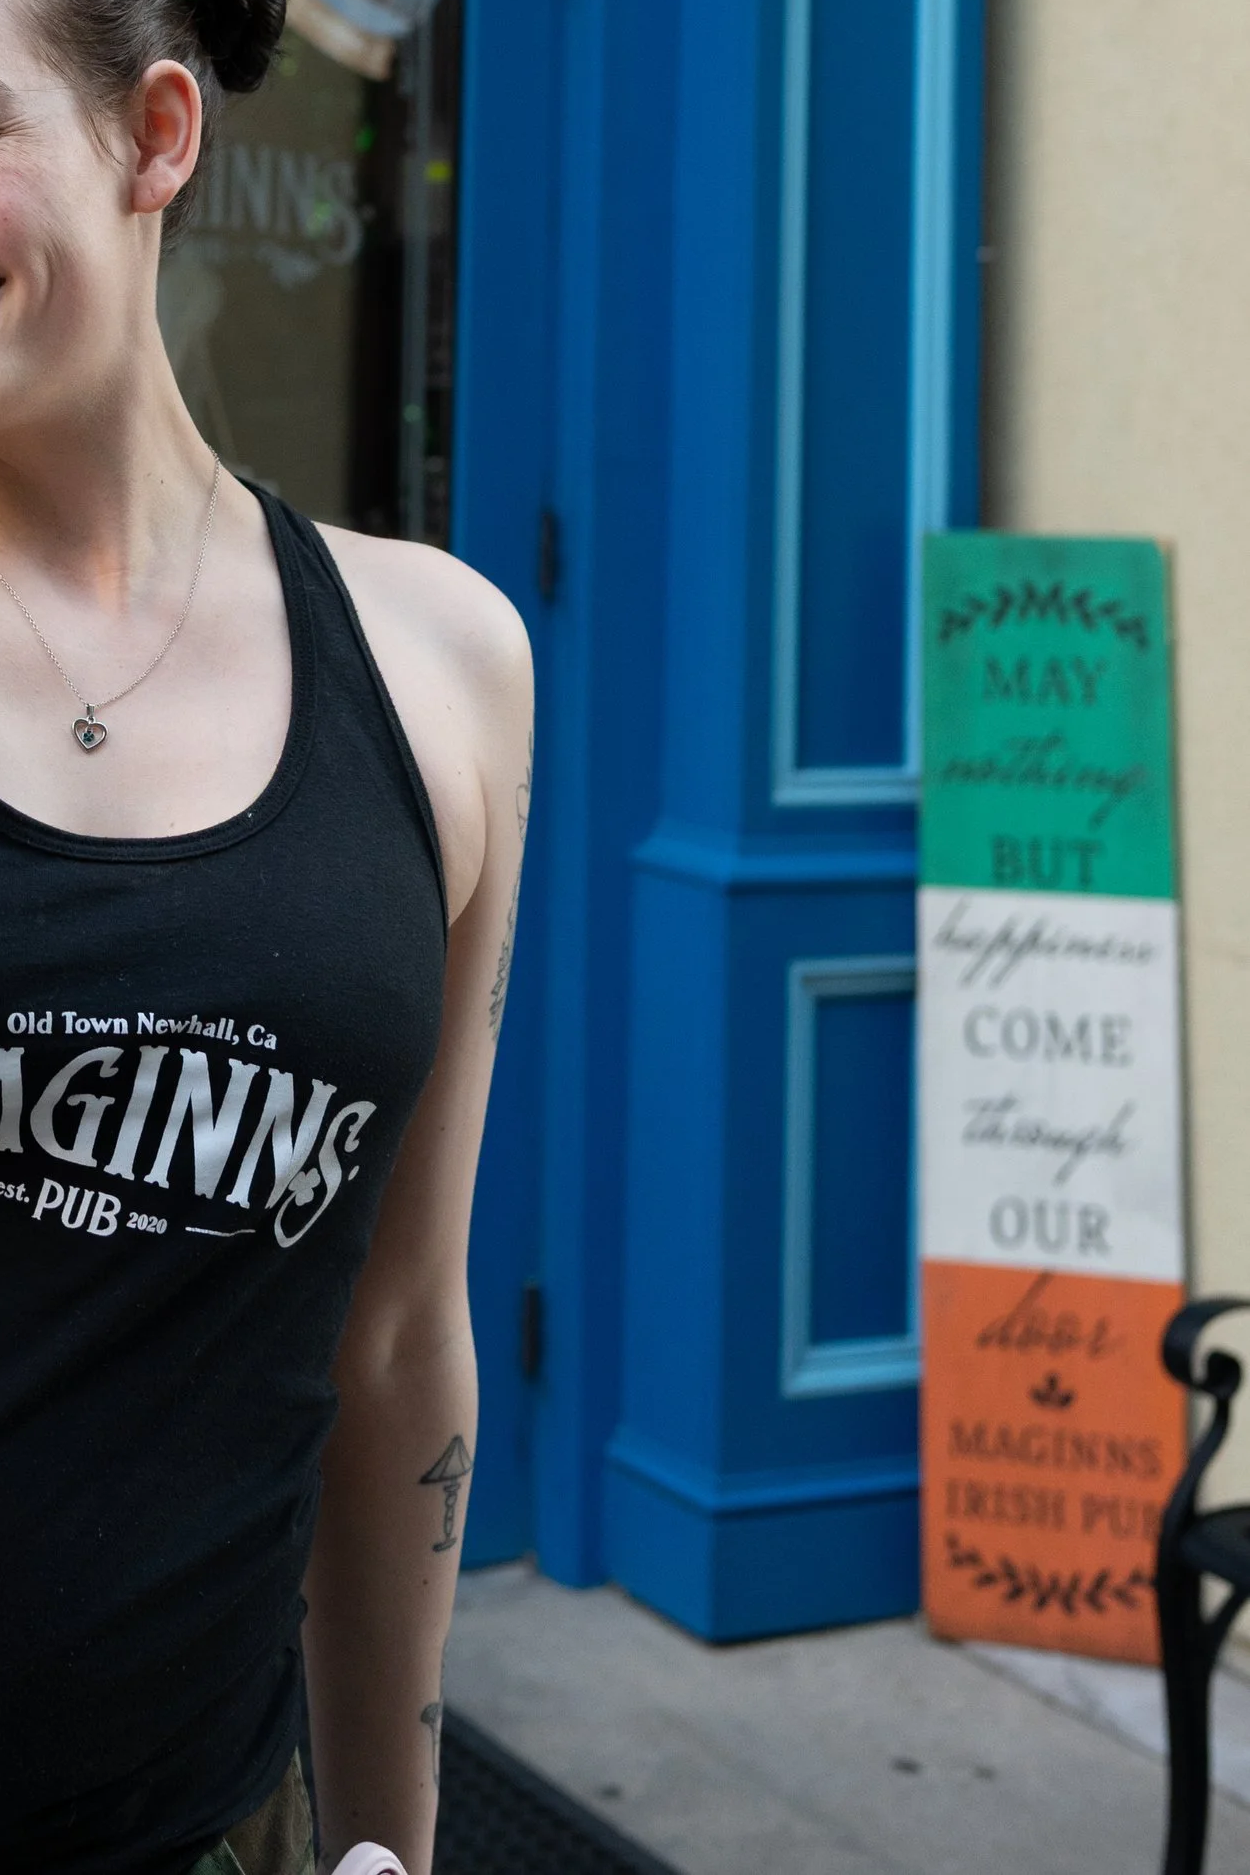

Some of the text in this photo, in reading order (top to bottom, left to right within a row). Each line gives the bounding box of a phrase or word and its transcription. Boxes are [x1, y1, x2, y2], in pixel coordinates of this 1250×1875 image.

[982, 654, 1107, 706] MAY
[990, 833, 1105, 889] BUT
[7, 1012, 278, 1051] Old Town Newhall, Ca
[963, 1004, 1134, 1068] COME
[32, 1178, 121, 1237] PUB
[126, 1212, 168, 1235] 2020
[988, 1194, 1113, 1257] OUR
[948, 1420, 1164, 1481] MAGINNS
[945, 1479, 1066, 1531] IRISH
